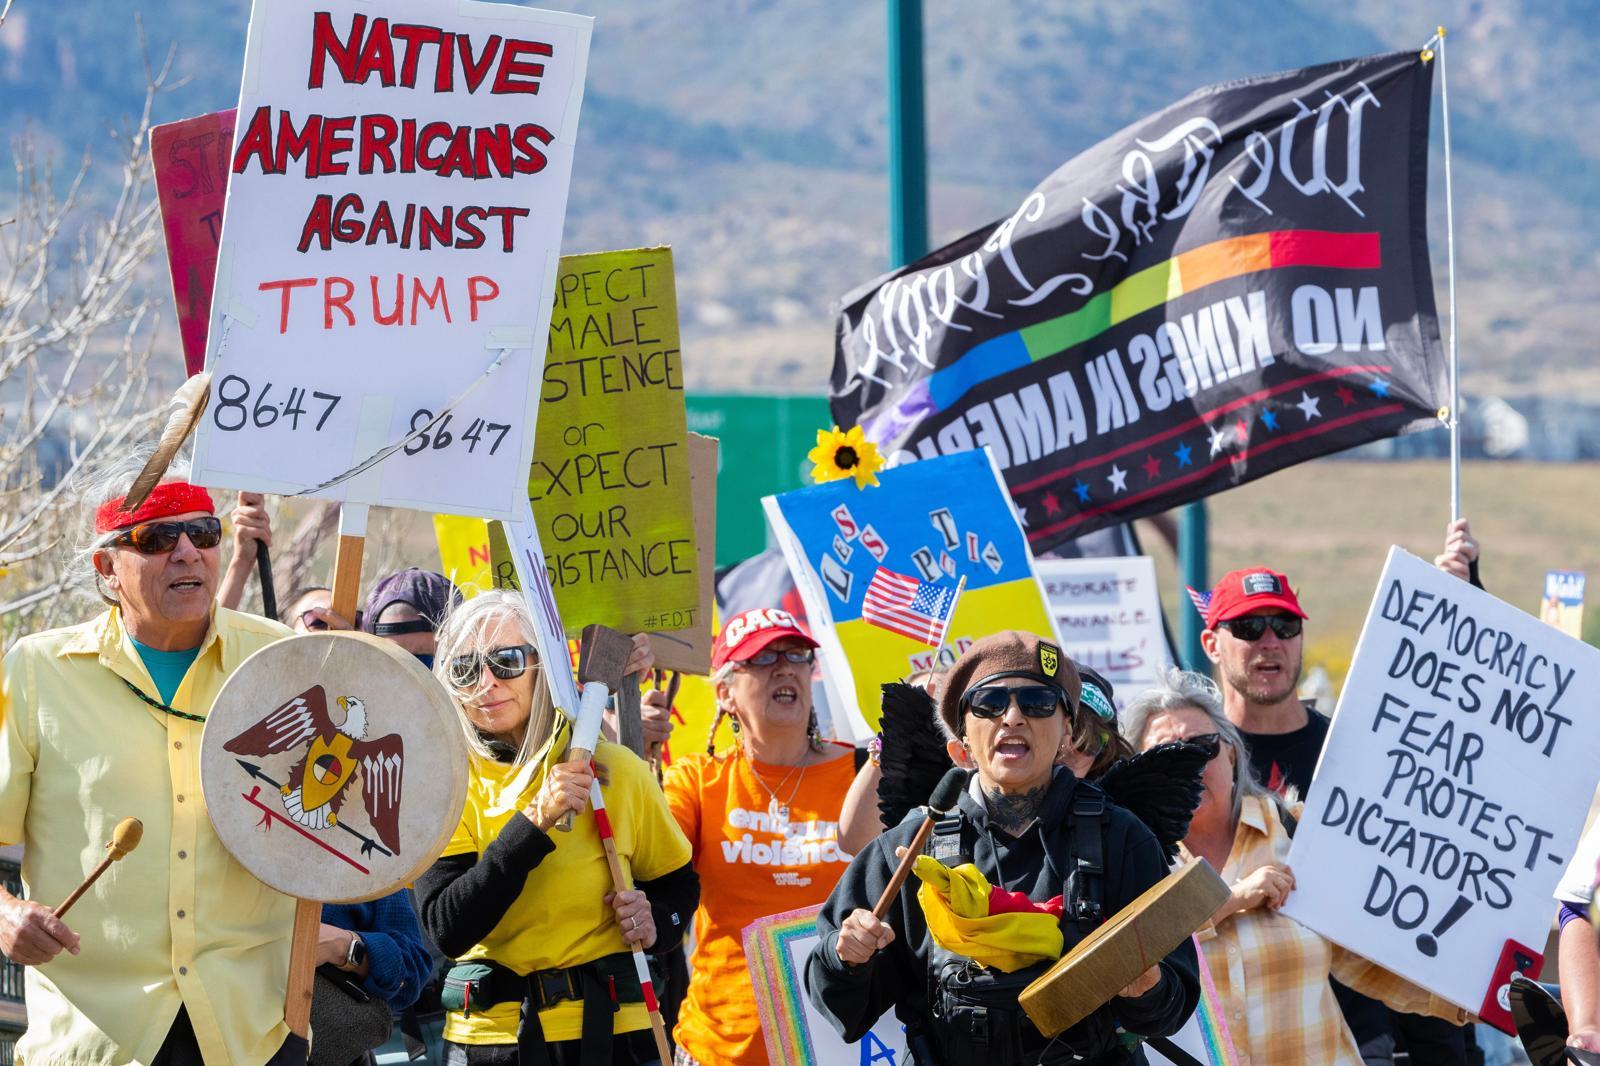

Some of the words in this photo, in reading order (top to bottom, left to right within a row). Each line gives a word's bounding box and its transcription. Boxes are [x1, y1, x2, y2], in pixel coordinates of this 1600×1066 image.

[308, 12, 553, 95] NATIVE
[232, 106, 554, 179] AMERICANS
[297, 194, 530, 253] AGAINST
[258, 273, 500, 334] TRUMP
[552, 264, 655, 309] PECT
[497, 540, 692, 590] RSISTANCE
[552, 505, 631, 542] OUR
[1381, 579, 1575, 713] DEMOCRACY
[1372, 692, 1484, 785] FEAR
[1388, 637, 1485, 713] DOES
[1490, 688, 1573, 758] NOT
[1321, 786, 1516, 909] DICTATORS
[1382, 749, 1563, 871] PROTEST-
[1363, 865, 1474, 958] DO!
